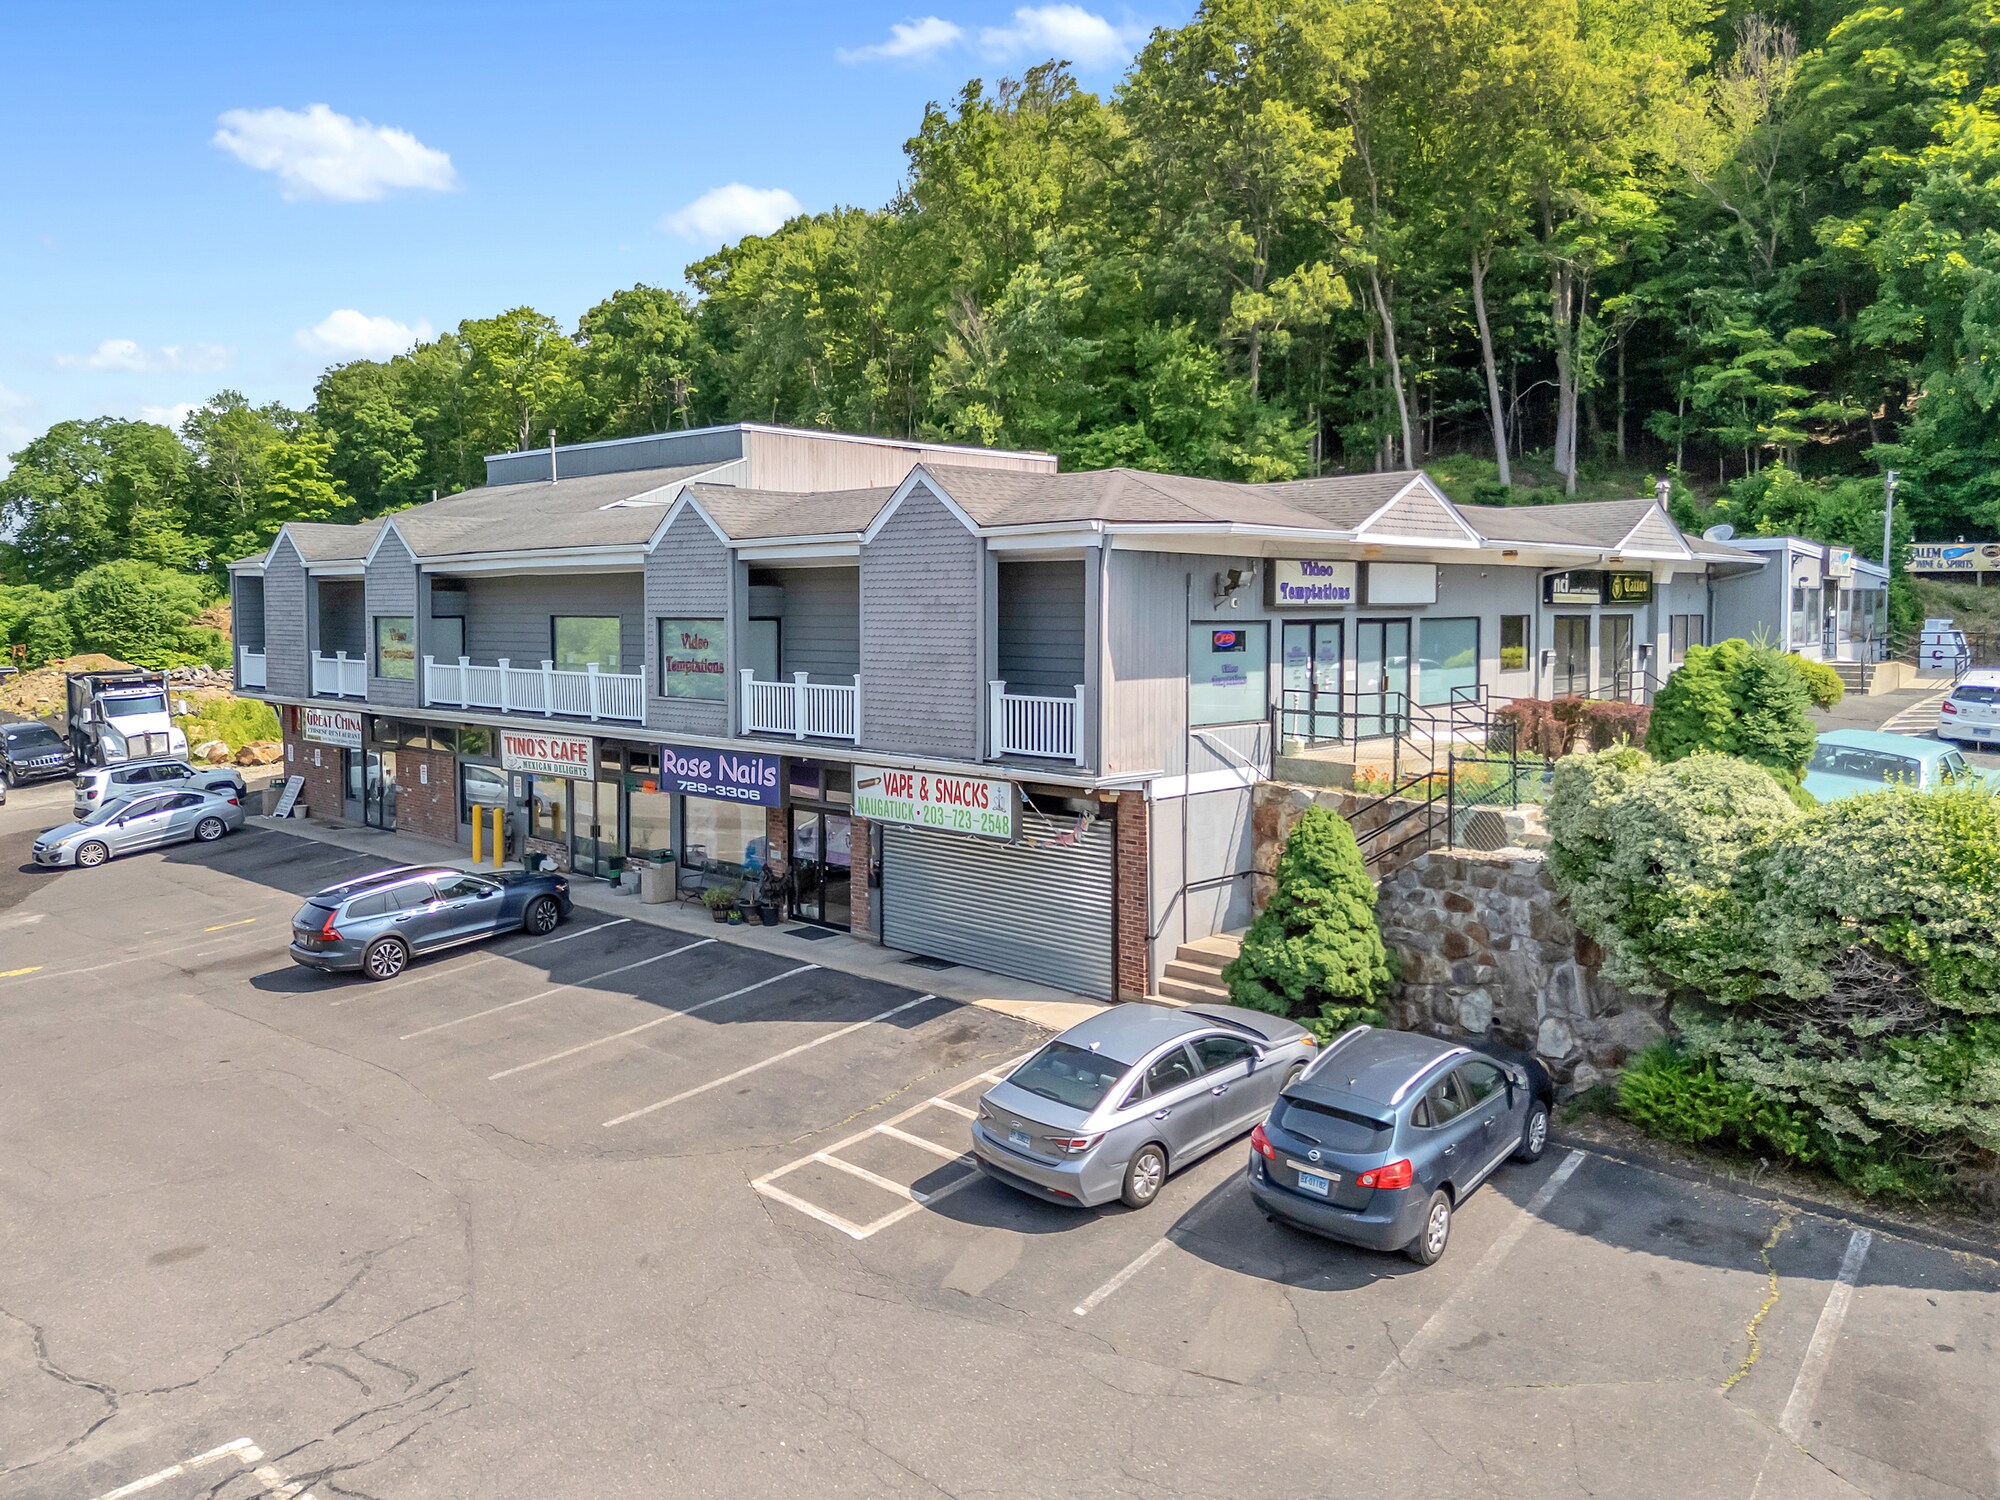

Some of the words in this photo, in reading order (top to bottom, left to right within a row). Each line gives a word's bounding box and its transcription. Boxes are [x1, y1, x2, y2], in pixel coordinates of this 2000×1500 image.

[1300, 560, 1333, 576] Video
[1916, 560, 1933, 568] WINE
[1936, 560, 1943, 568] &
[1946, 560, 1973, 568] SPIRITS
[1280, 582, 1350, 604] Temptations
[680, 632, 709, 649] Video
[666, 656, 724, 675] Temptations
[307, 711, 332, 728] GREAT
[335, 713, 363, 731] CHINA
[504, 736, 547, 759] TINO'S
[551, 741, 587, 762] CAFE
[523, 760, 552, 771] MEXICAN
[554, 763, 587, 776] DELIGHTS
[663, 749, 712, 778] Rose
[718, 754, 776, 787] Nails
[677, 780, 761, 800] 729-3306
[883, 772, 913, 799] VAPE
[920, 776, 929, 801] &
[935, 778, 989, 809] SNACKS
[858, 796, 915, 821] NAUGATUCK
[923, 805, 1009, 835] 203-723-2548
